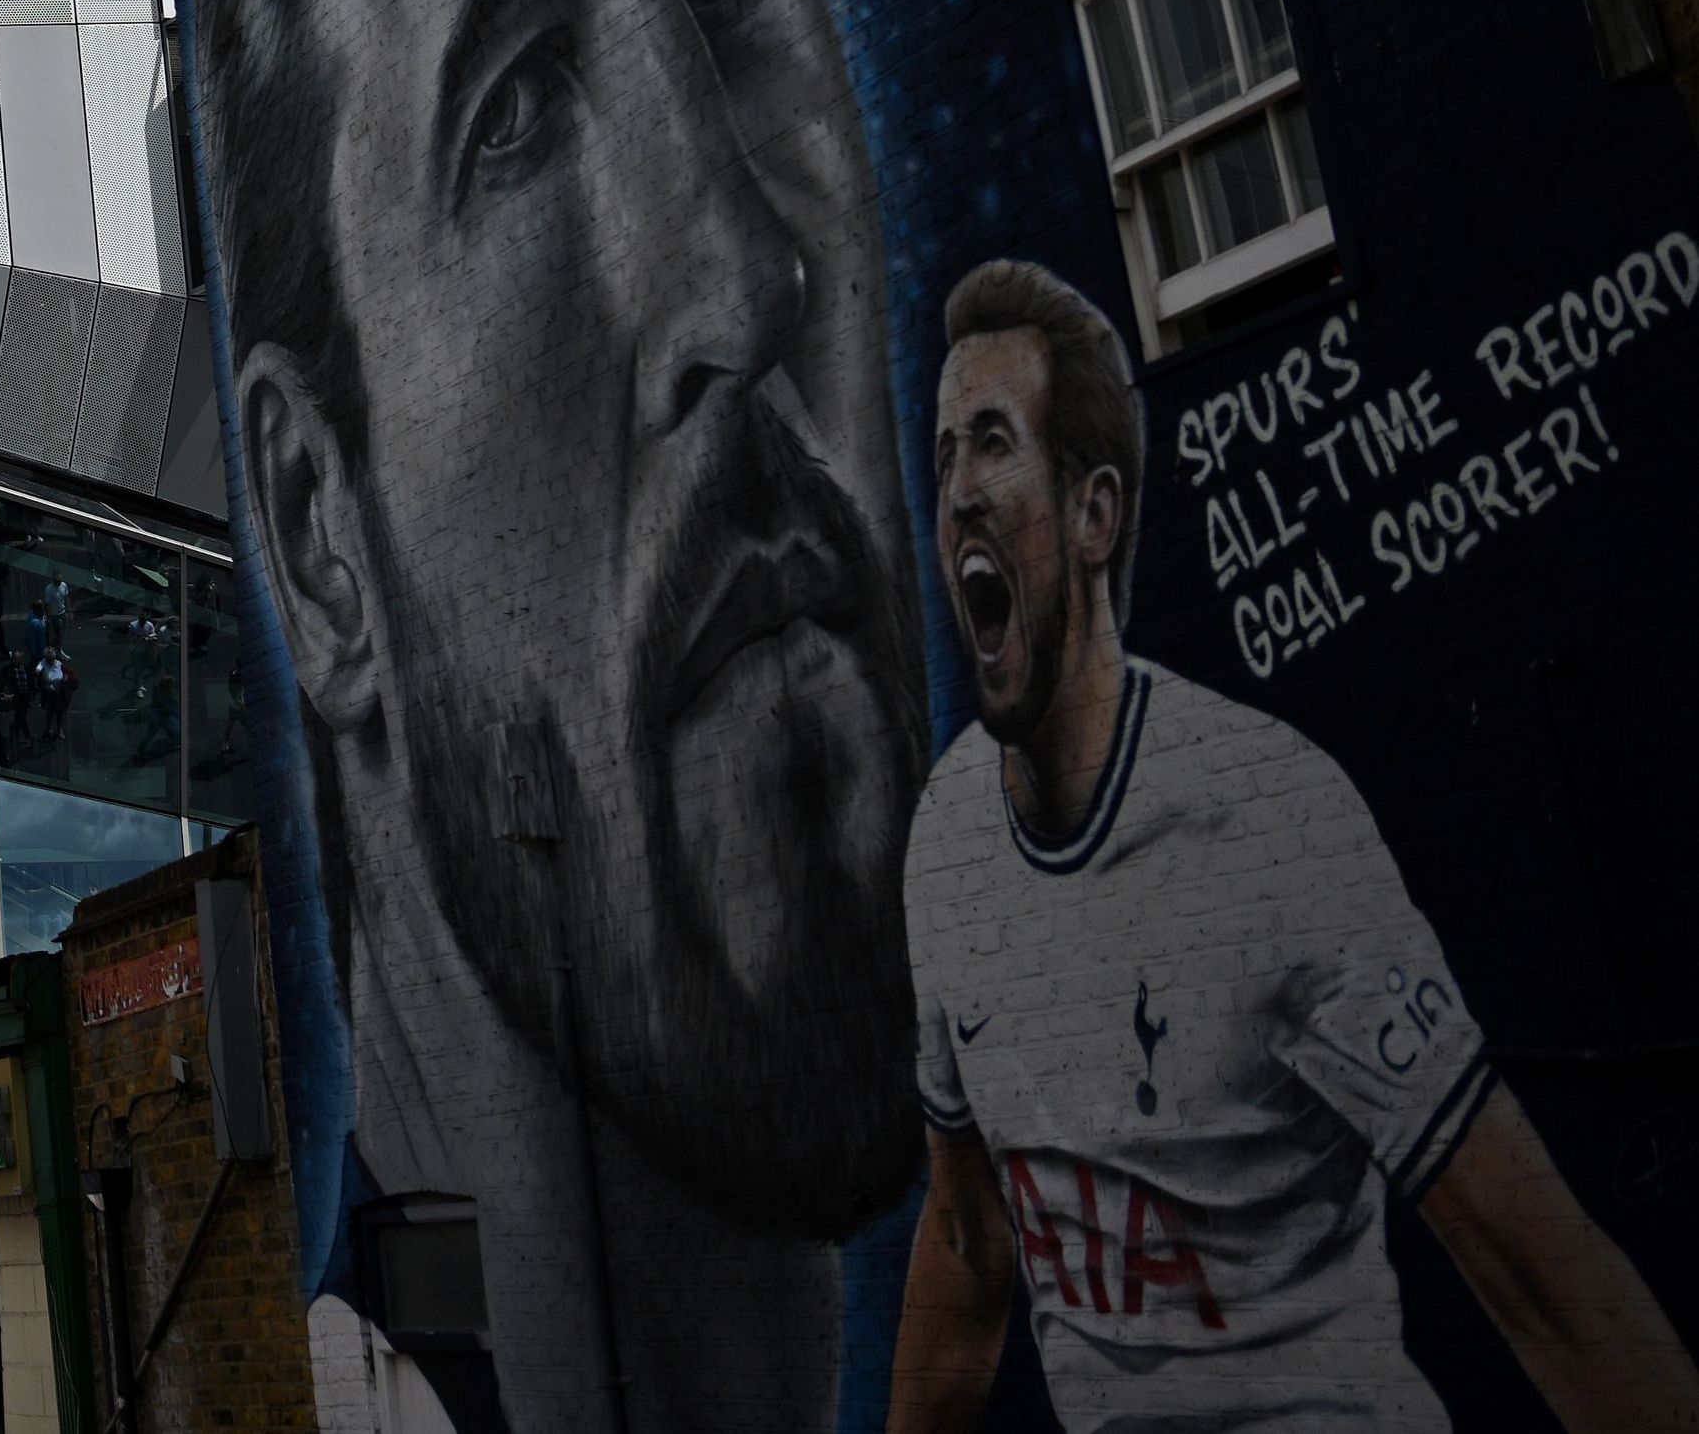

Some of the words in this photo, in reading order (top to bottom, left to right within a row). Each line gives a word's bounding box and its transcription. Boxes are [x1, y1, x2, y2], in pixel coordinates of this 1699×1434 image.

[1206, 370, 1459, 590] ALL-TIME
[1476, 231, 1699, 400] RECORD
[1233, 547, 1365, 678] GOAL
[1372, 383, 1619, 593] SCORER!
[1009, 1152, 1226, 1329] AIA
